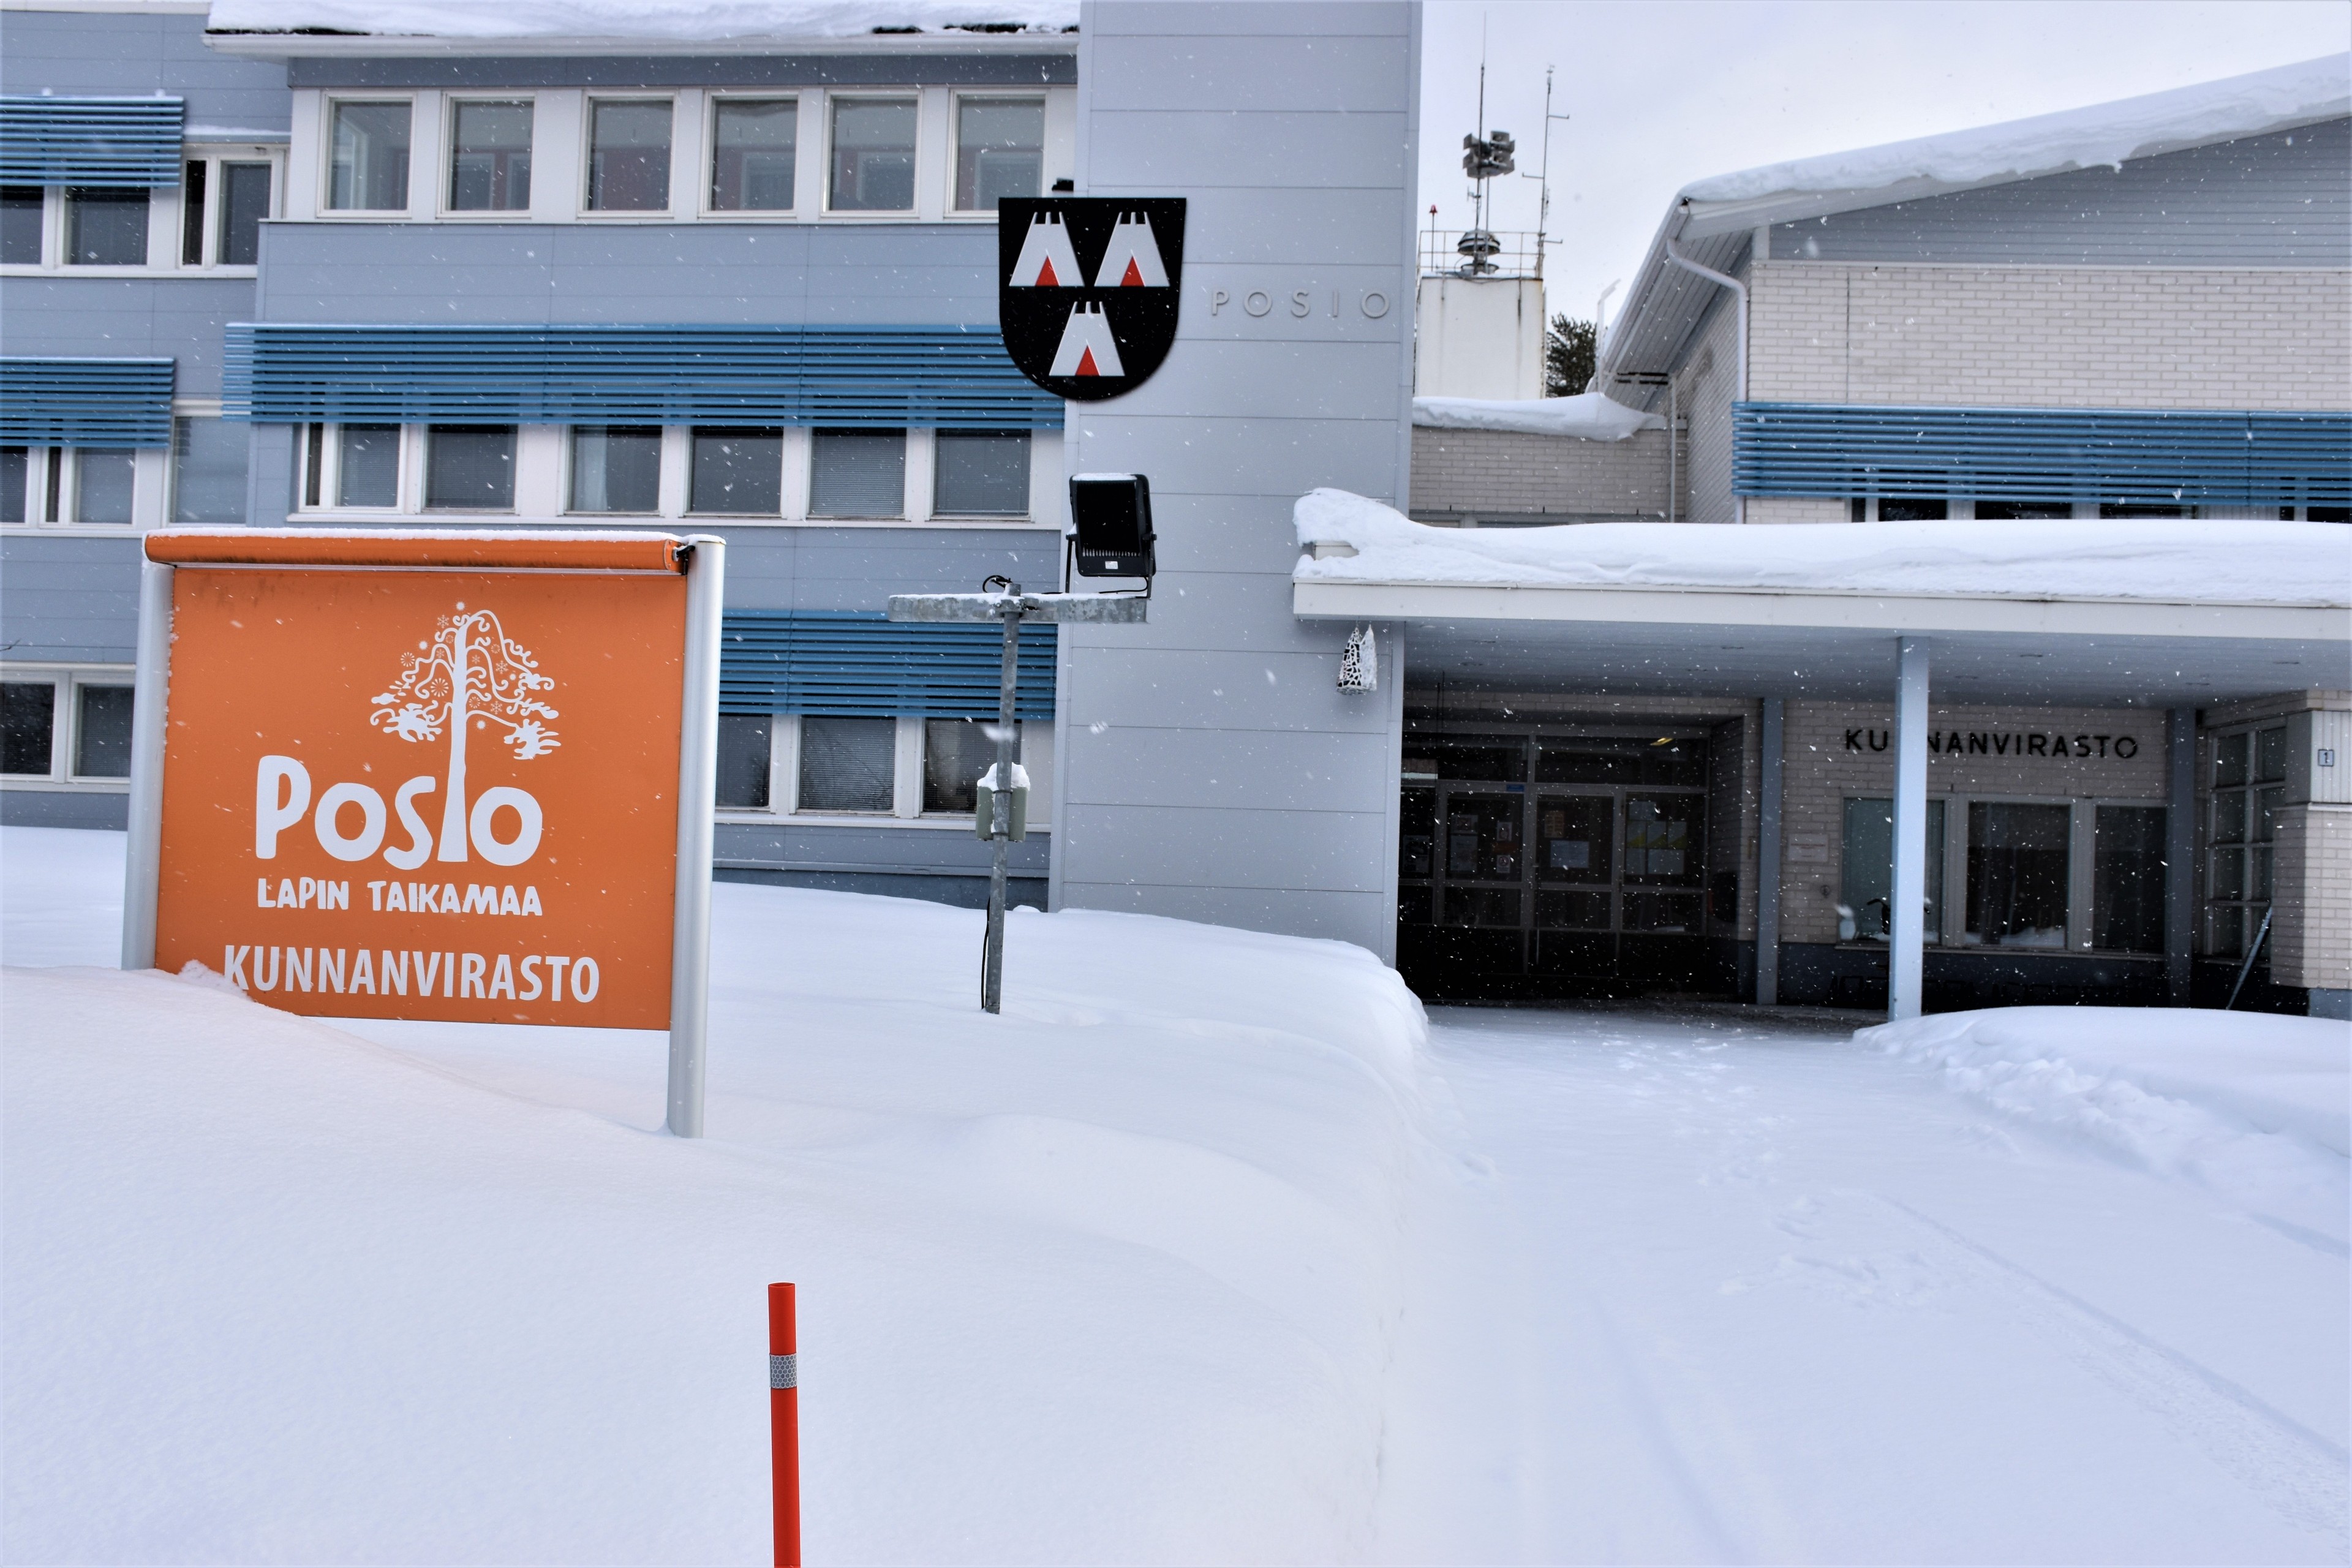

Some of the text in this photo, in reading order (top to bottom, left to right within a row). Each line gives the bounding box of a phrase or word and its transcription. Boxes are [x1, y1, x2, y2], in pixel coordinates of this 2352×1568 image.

[1212, 289, 1390, 318] POSIO
[1845, 729, 2138, 758] KUNANVIRASTO
[2323, 752, 2328, 764] 1
[258, 877, 542, 916] LAPIN TAIKAMAA
[224, 944, 600, 1003] KUNNANVIRASTO
